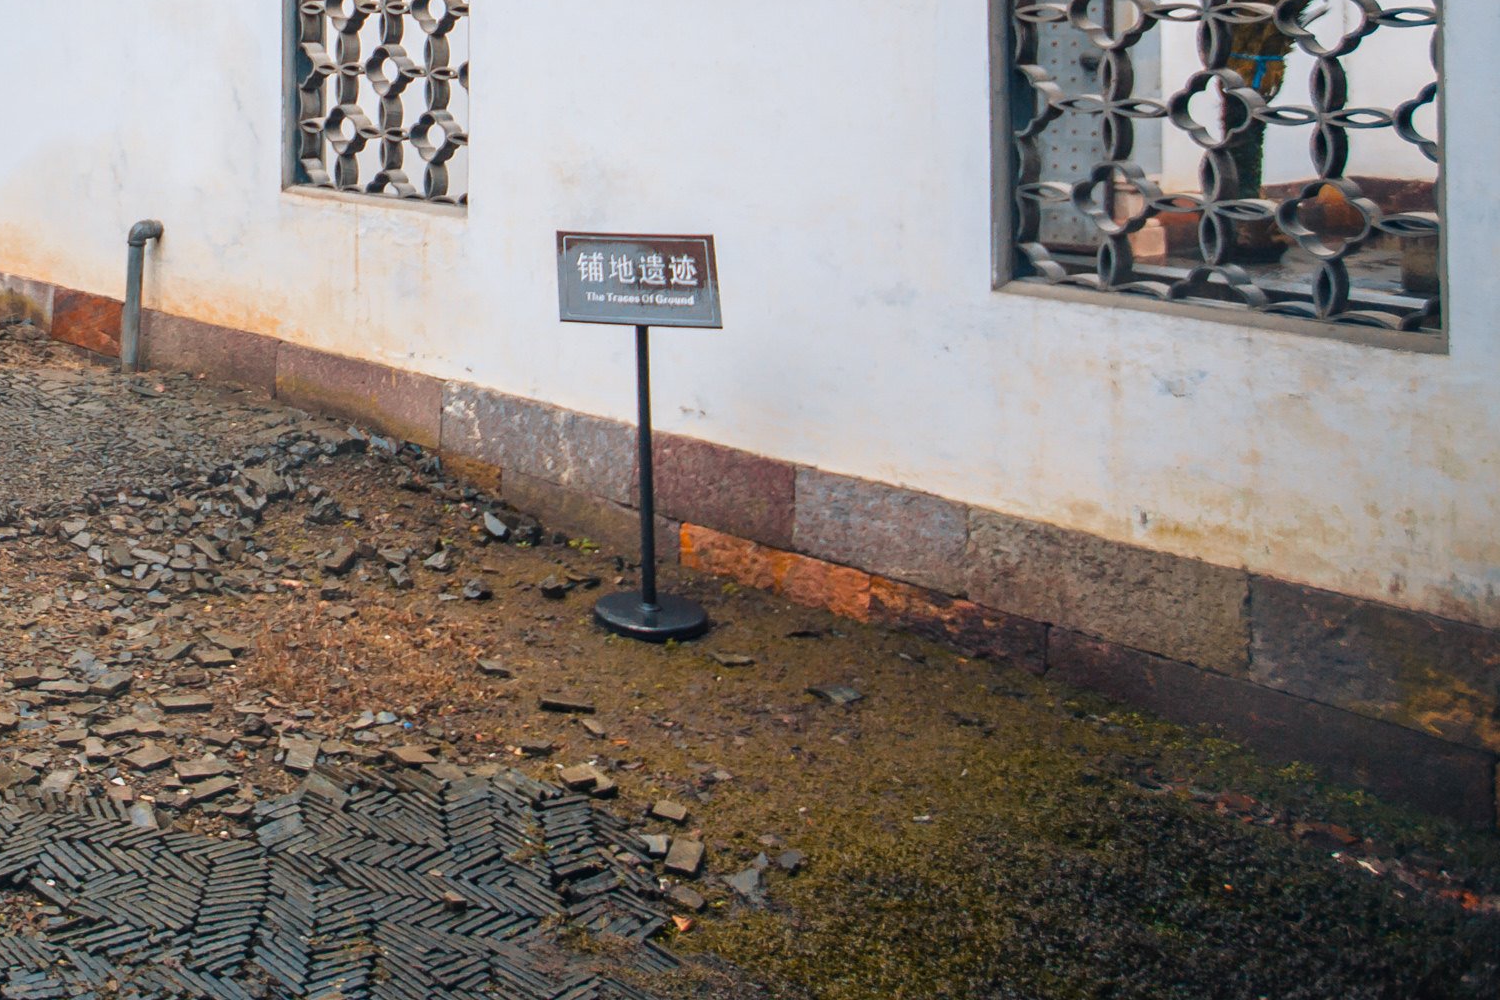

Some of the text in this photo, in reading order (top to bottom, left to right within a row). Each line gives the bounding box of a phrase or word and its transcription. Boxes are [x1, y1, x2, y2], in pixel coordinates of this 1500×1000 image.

[577, 252, 698, 285] 铺地遗迹
[586, 291, 695, 305] The Traces Of Ground
